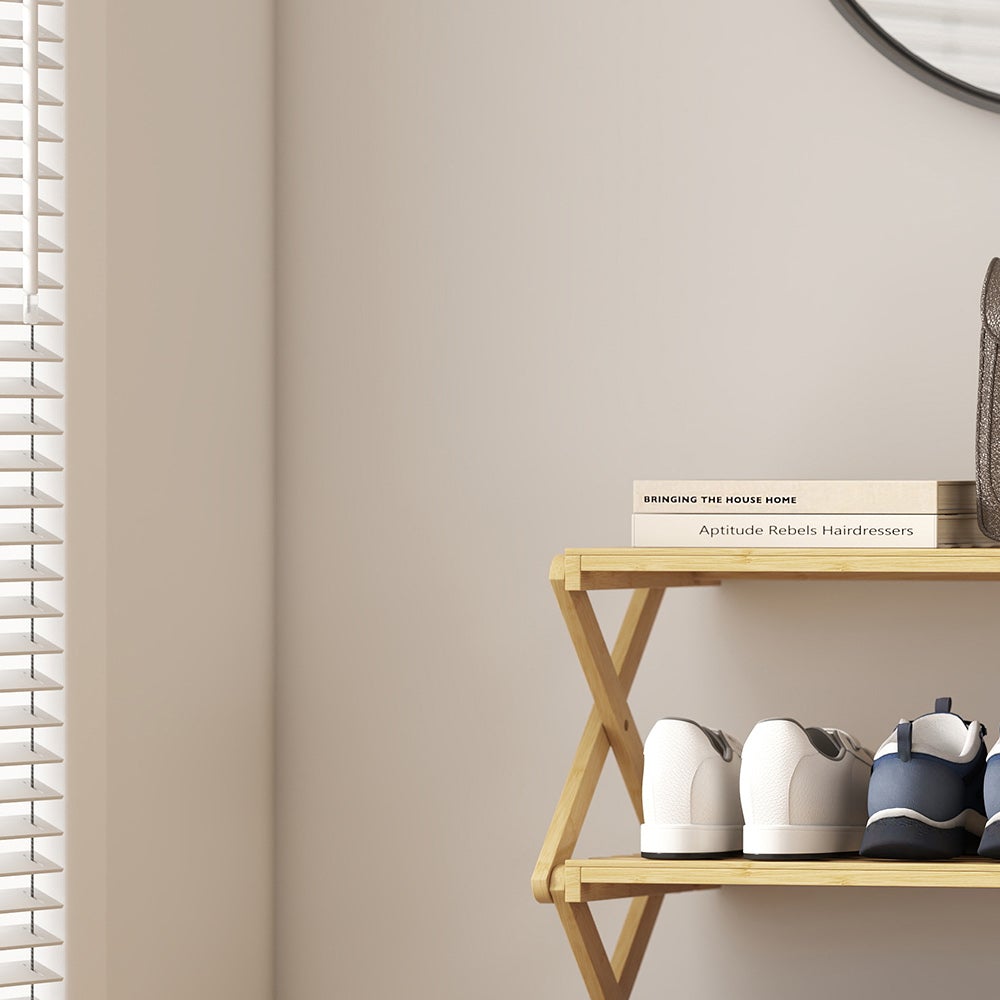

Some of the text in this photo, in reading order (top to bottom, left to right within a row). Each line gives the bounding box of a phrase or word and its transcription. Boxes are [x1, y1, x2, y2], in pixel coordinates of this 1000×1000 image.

[643, 495, 797, 505] BRINGING THE HOUSE HOME
[698, 524, 914, 538] Aptitude Rebels Hairdressers
